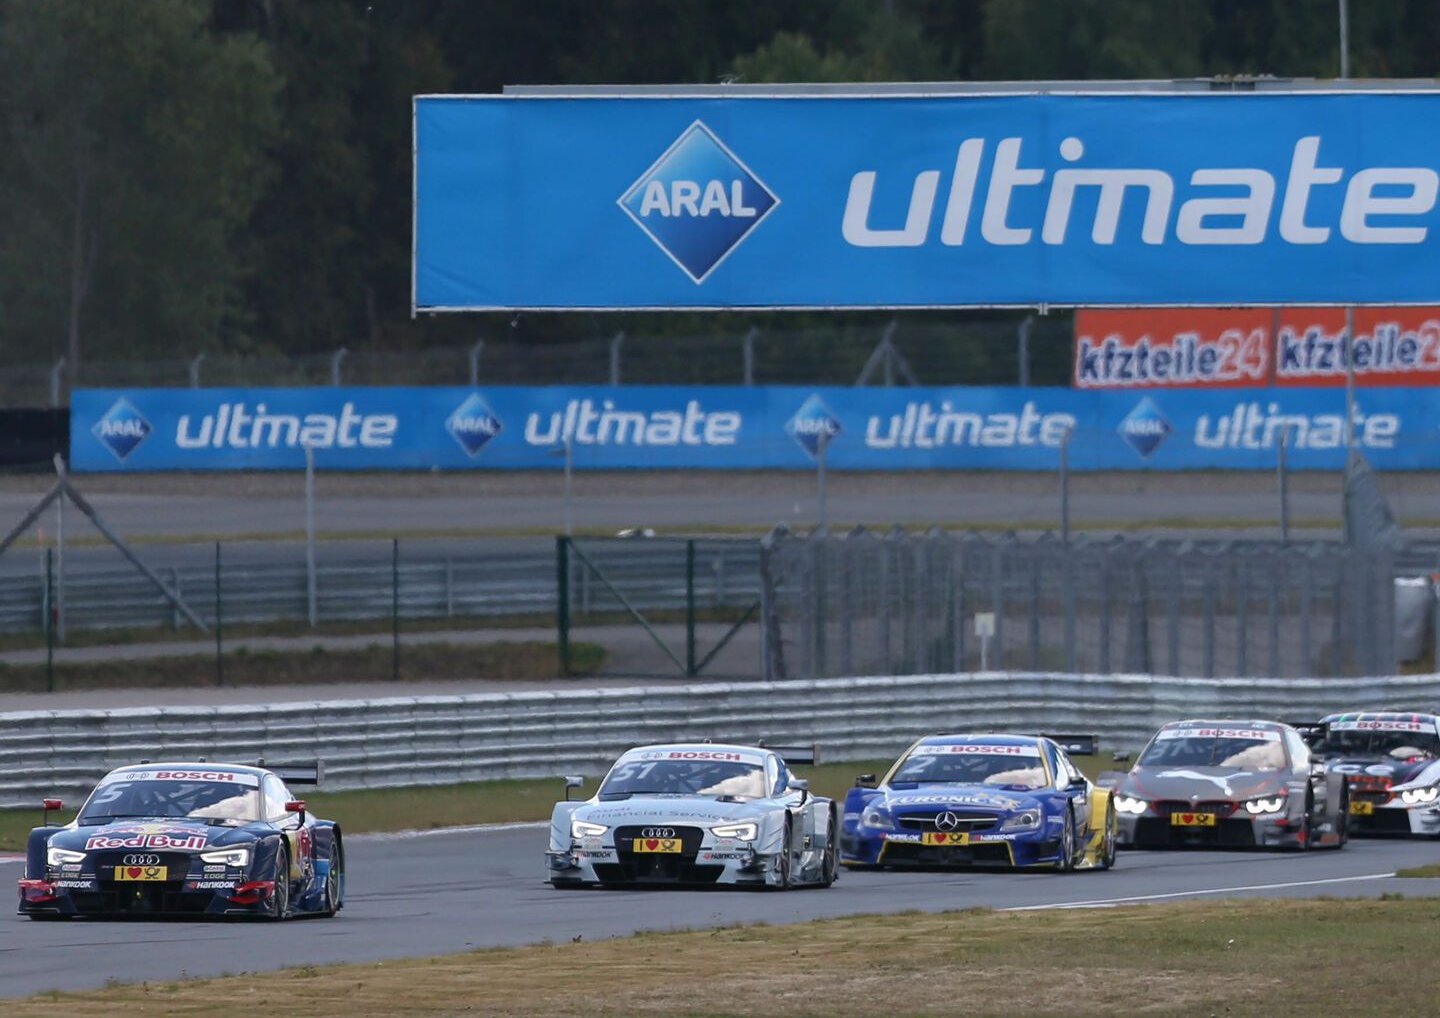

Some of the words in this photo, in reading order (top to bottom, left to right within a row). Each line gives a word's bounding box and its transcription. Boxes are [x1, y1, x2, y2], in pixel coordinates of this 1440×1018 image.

[640, 179, 757, 218] ARAL
[840, 134, 1440, 248] ultimate
[1075, 327, 1268, 388] kfzteile24
[99, 419, 144, 439] ARAL
[176, 402, 398, 450] ultimate
[452, 415, 496, 435] ARAL
[525, 399, 742, 446] ultimate
[865, 400, 1077, 449] ultimate
[1194, 401, 1400, 450] ultimate
[1198, 729, 1265, 739] BOSCH
[1357, 722, 1422, 731] BOSCH
[668, 751, 741, 761] BOSCH
[951, 745, 1021, 755] BOSCH
[611, 762, 660, 782] 51
[903, 755, 937, 774] 2
[155, 771, 234, 781] BOSCH
[93, 783, 132, 805] 5
[587, 810, 664, 821] Financial
[85, 836, 145, 851] Red
[146, 834, 207, 851] Bull
